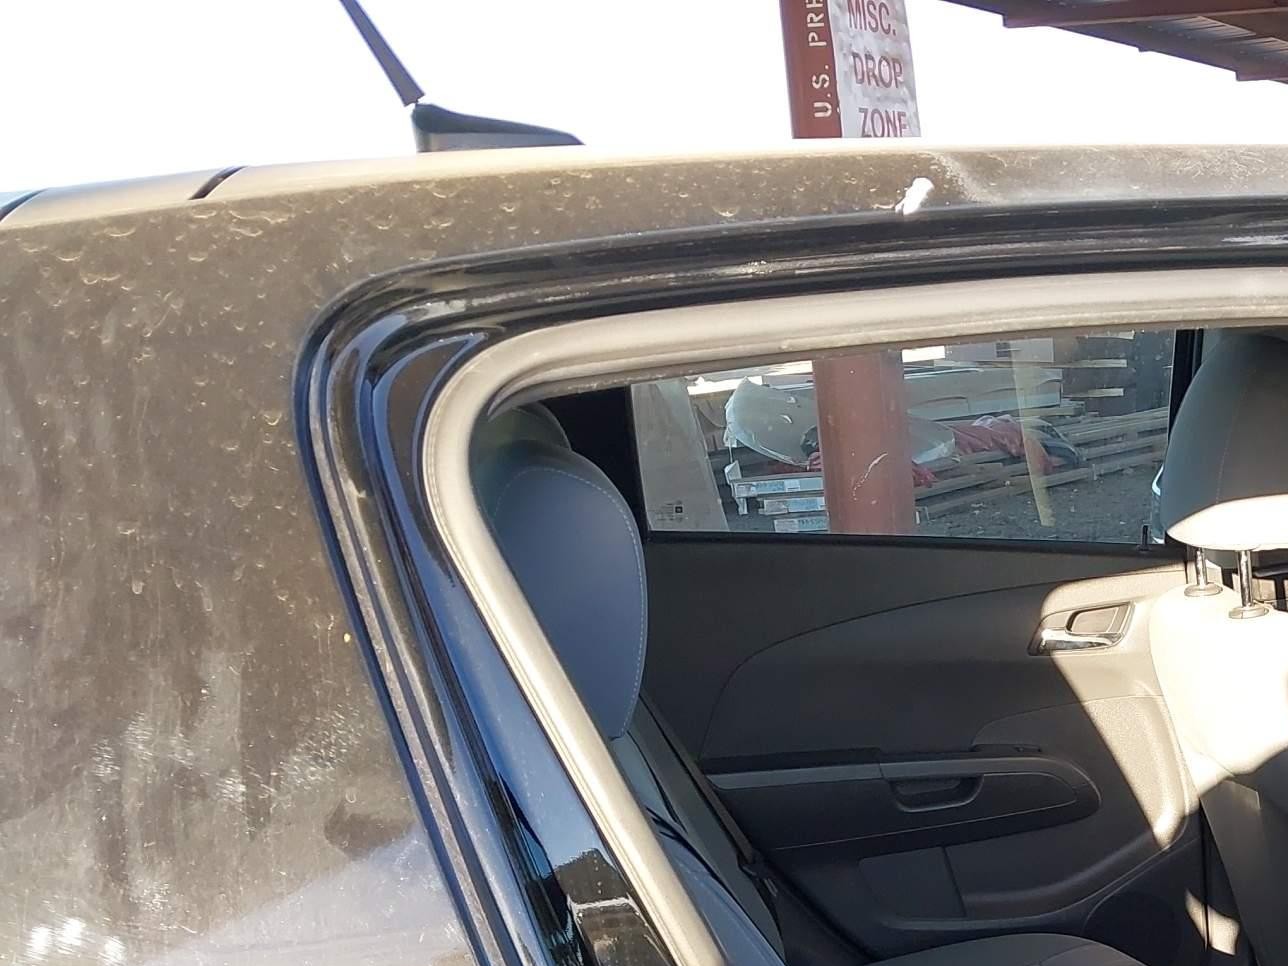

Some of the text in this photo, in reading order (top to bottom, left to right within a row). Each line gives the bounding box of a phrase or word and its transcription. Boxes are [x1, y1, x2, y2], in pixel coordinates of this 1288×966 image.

[847, 0, 896, 36] MISC.
[852, 51, 903, 89] DROP
[812, 64, 832, 118] U.S.
